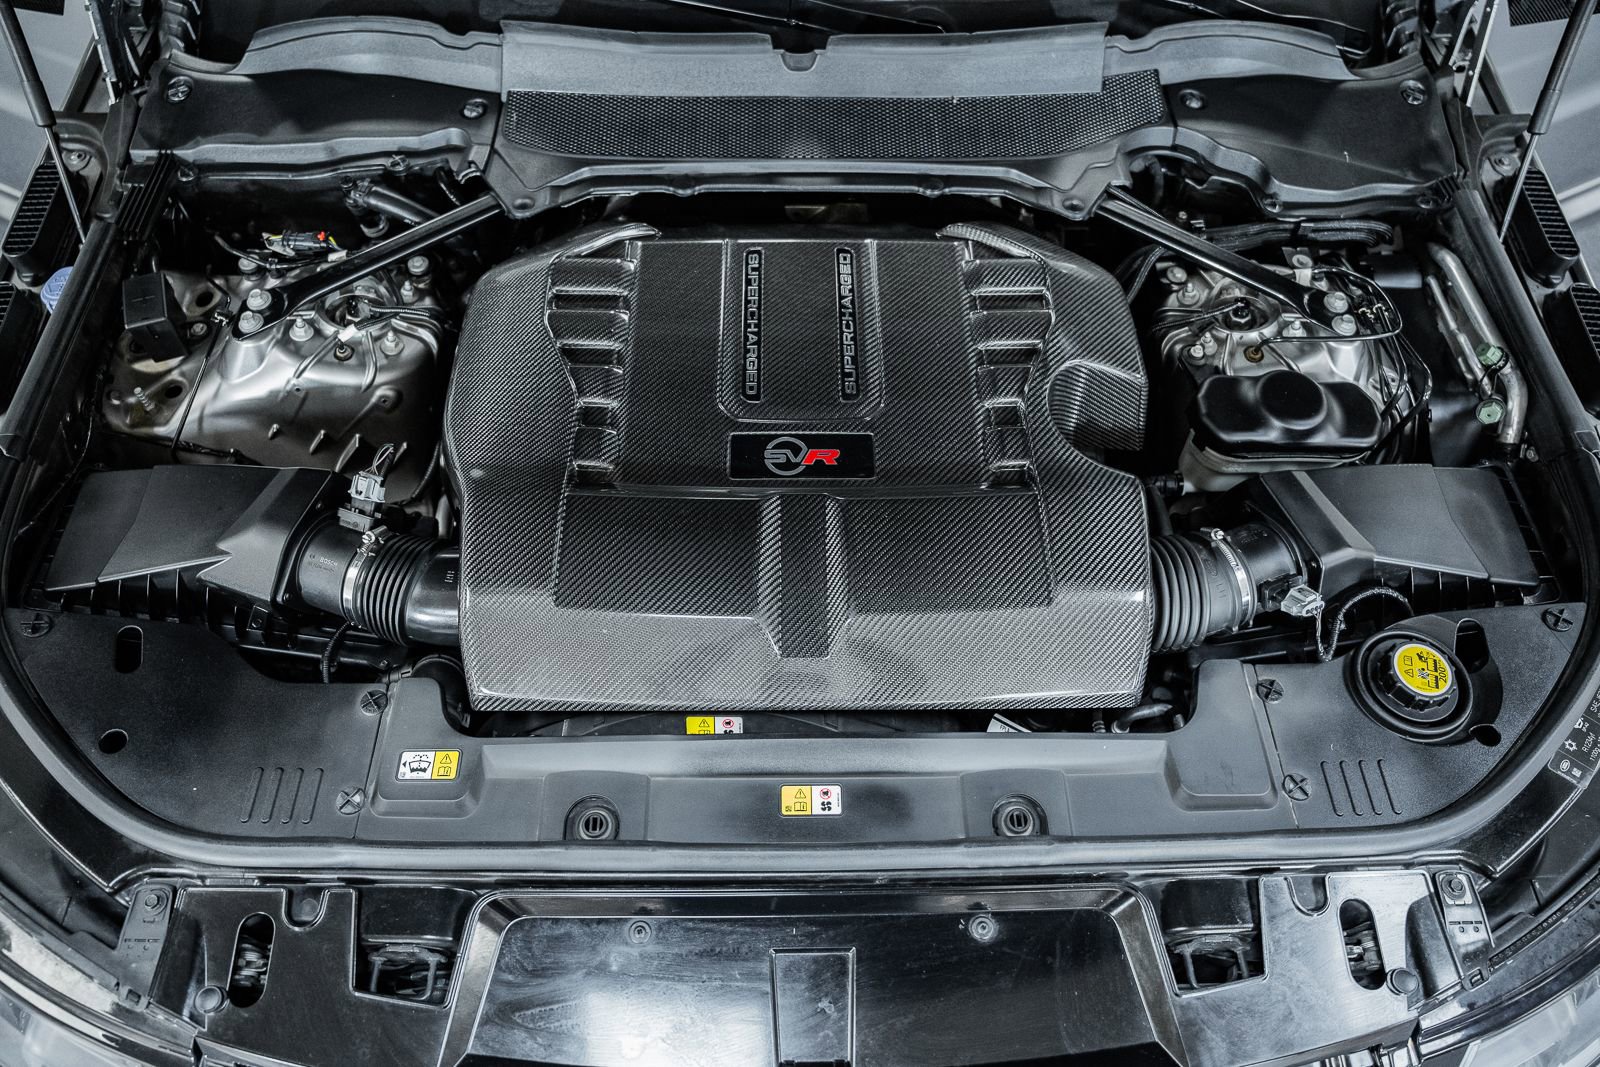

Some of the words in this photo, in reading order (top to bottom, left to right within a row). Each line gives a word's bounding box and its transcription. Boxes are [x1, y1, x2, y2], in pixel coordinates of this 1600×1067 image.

[746, 254, 759, 395] SUPERCHARGED
[839, 253, 857, 395] SUPERCHARGED
[764, 443, 840, 469] SVR
[1438, 667, 1447, 683] 200
